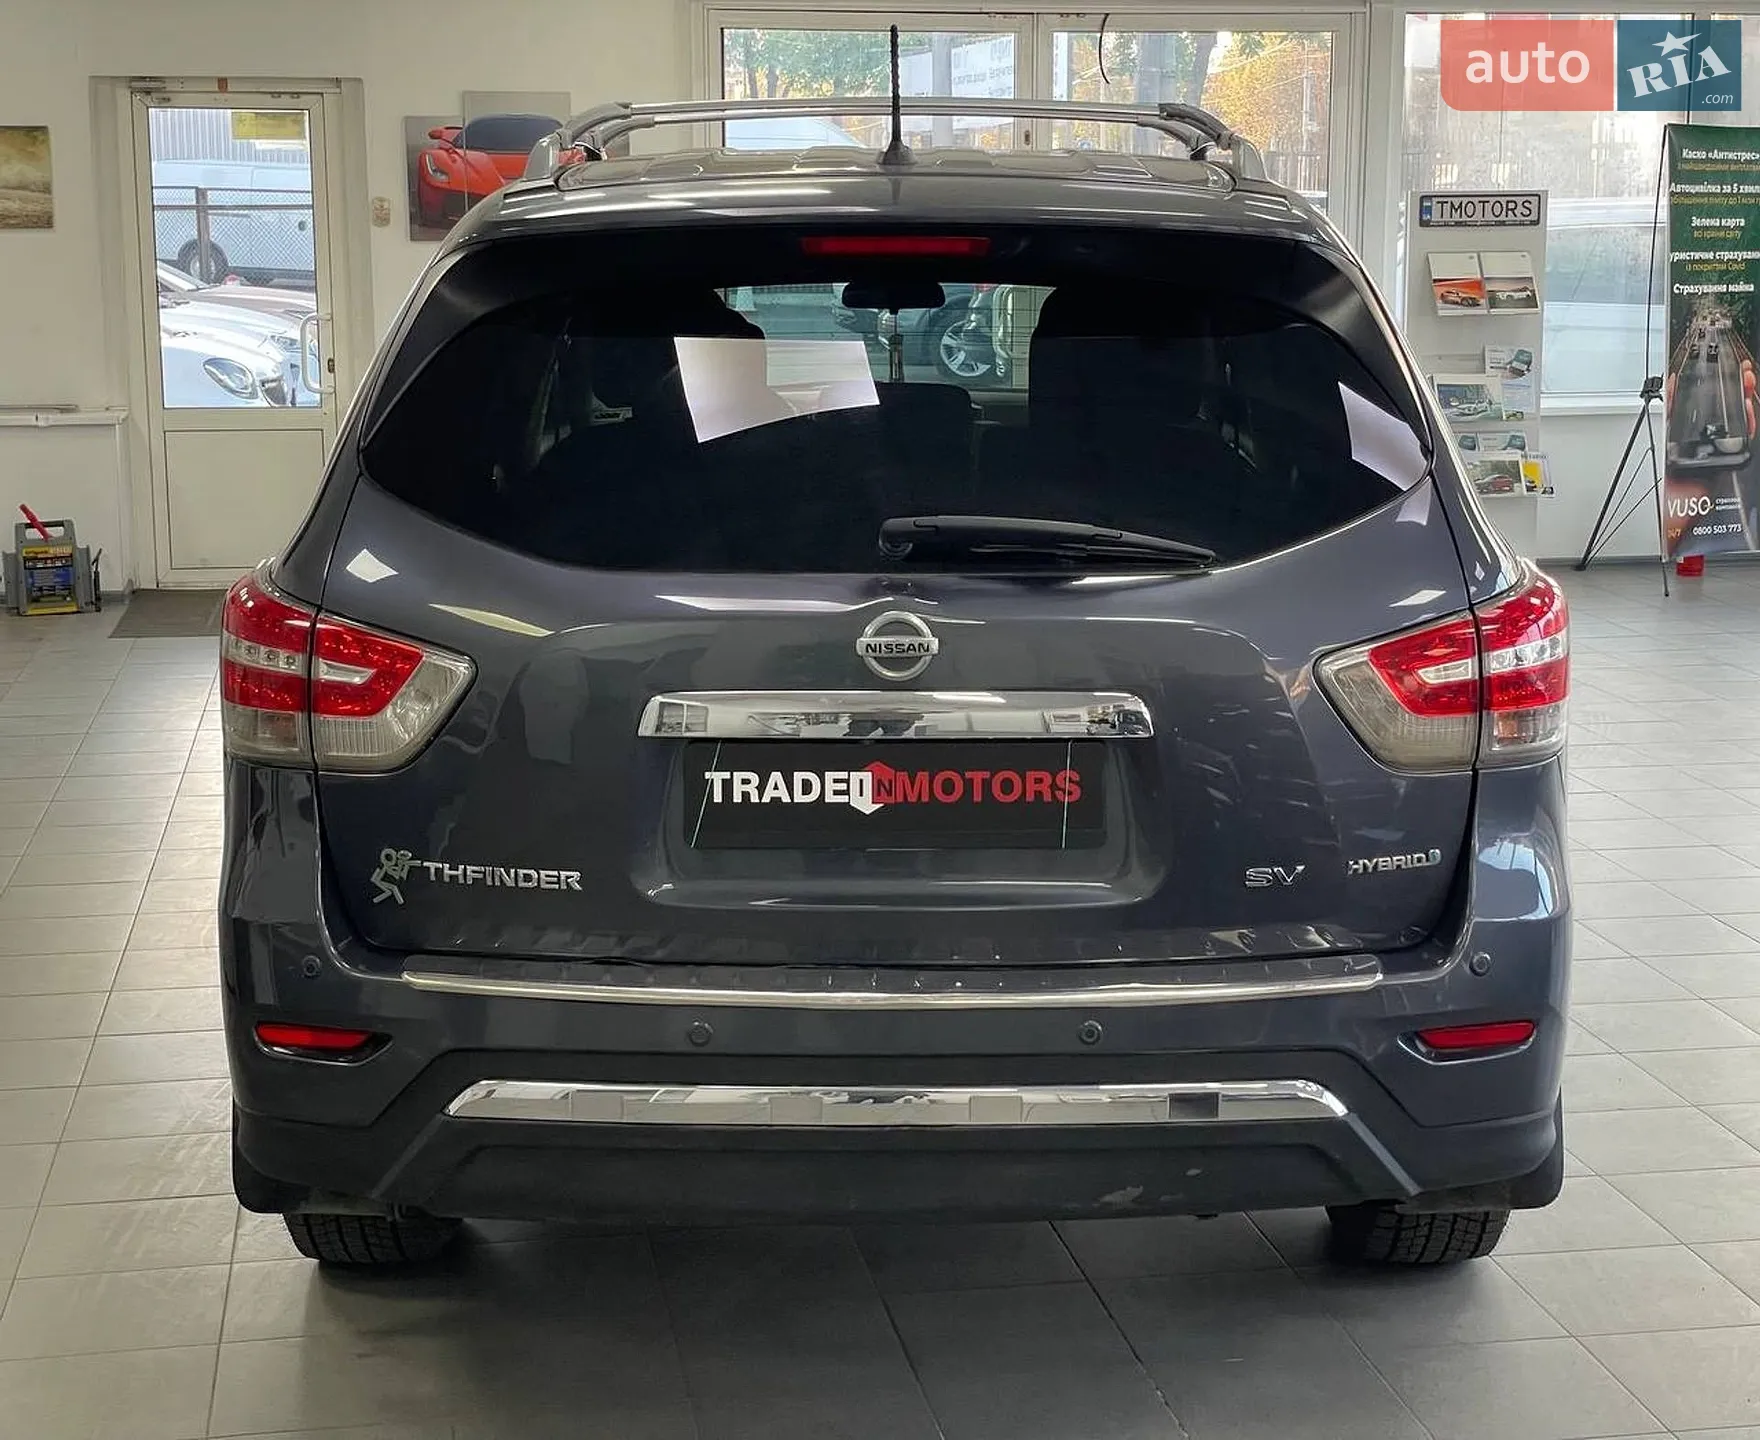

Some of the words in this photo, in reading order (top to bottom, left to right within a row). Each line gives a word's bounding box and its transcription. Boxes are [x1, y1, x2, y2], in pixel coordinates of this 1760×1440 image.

[1682, 148, 1707, 159] Каско
[1732, 183, 1739, 193] 5
[1436, 200, 1533, 219] TMOTORS
[1691, 216, 1720, 227] Зелена
[1721, 218, 1745, 228] карта
[1673, 283, 1727, 295] Страхування
[1667, 496, 1711, 518] VUSO
[1692, 526, 1713, 536] 0800
[1713, 524, 1727, 534] 503
[1728, 523, 1742, 532] 773
[865, 643, 930, 654] NISSAN
[704, 770, 850, 804] TRADE
[895, 769, 1082, 804] MOTORS
[1244, 865, 1306, 888] SV
[1348, 852, 1430, 876] HYBRID
